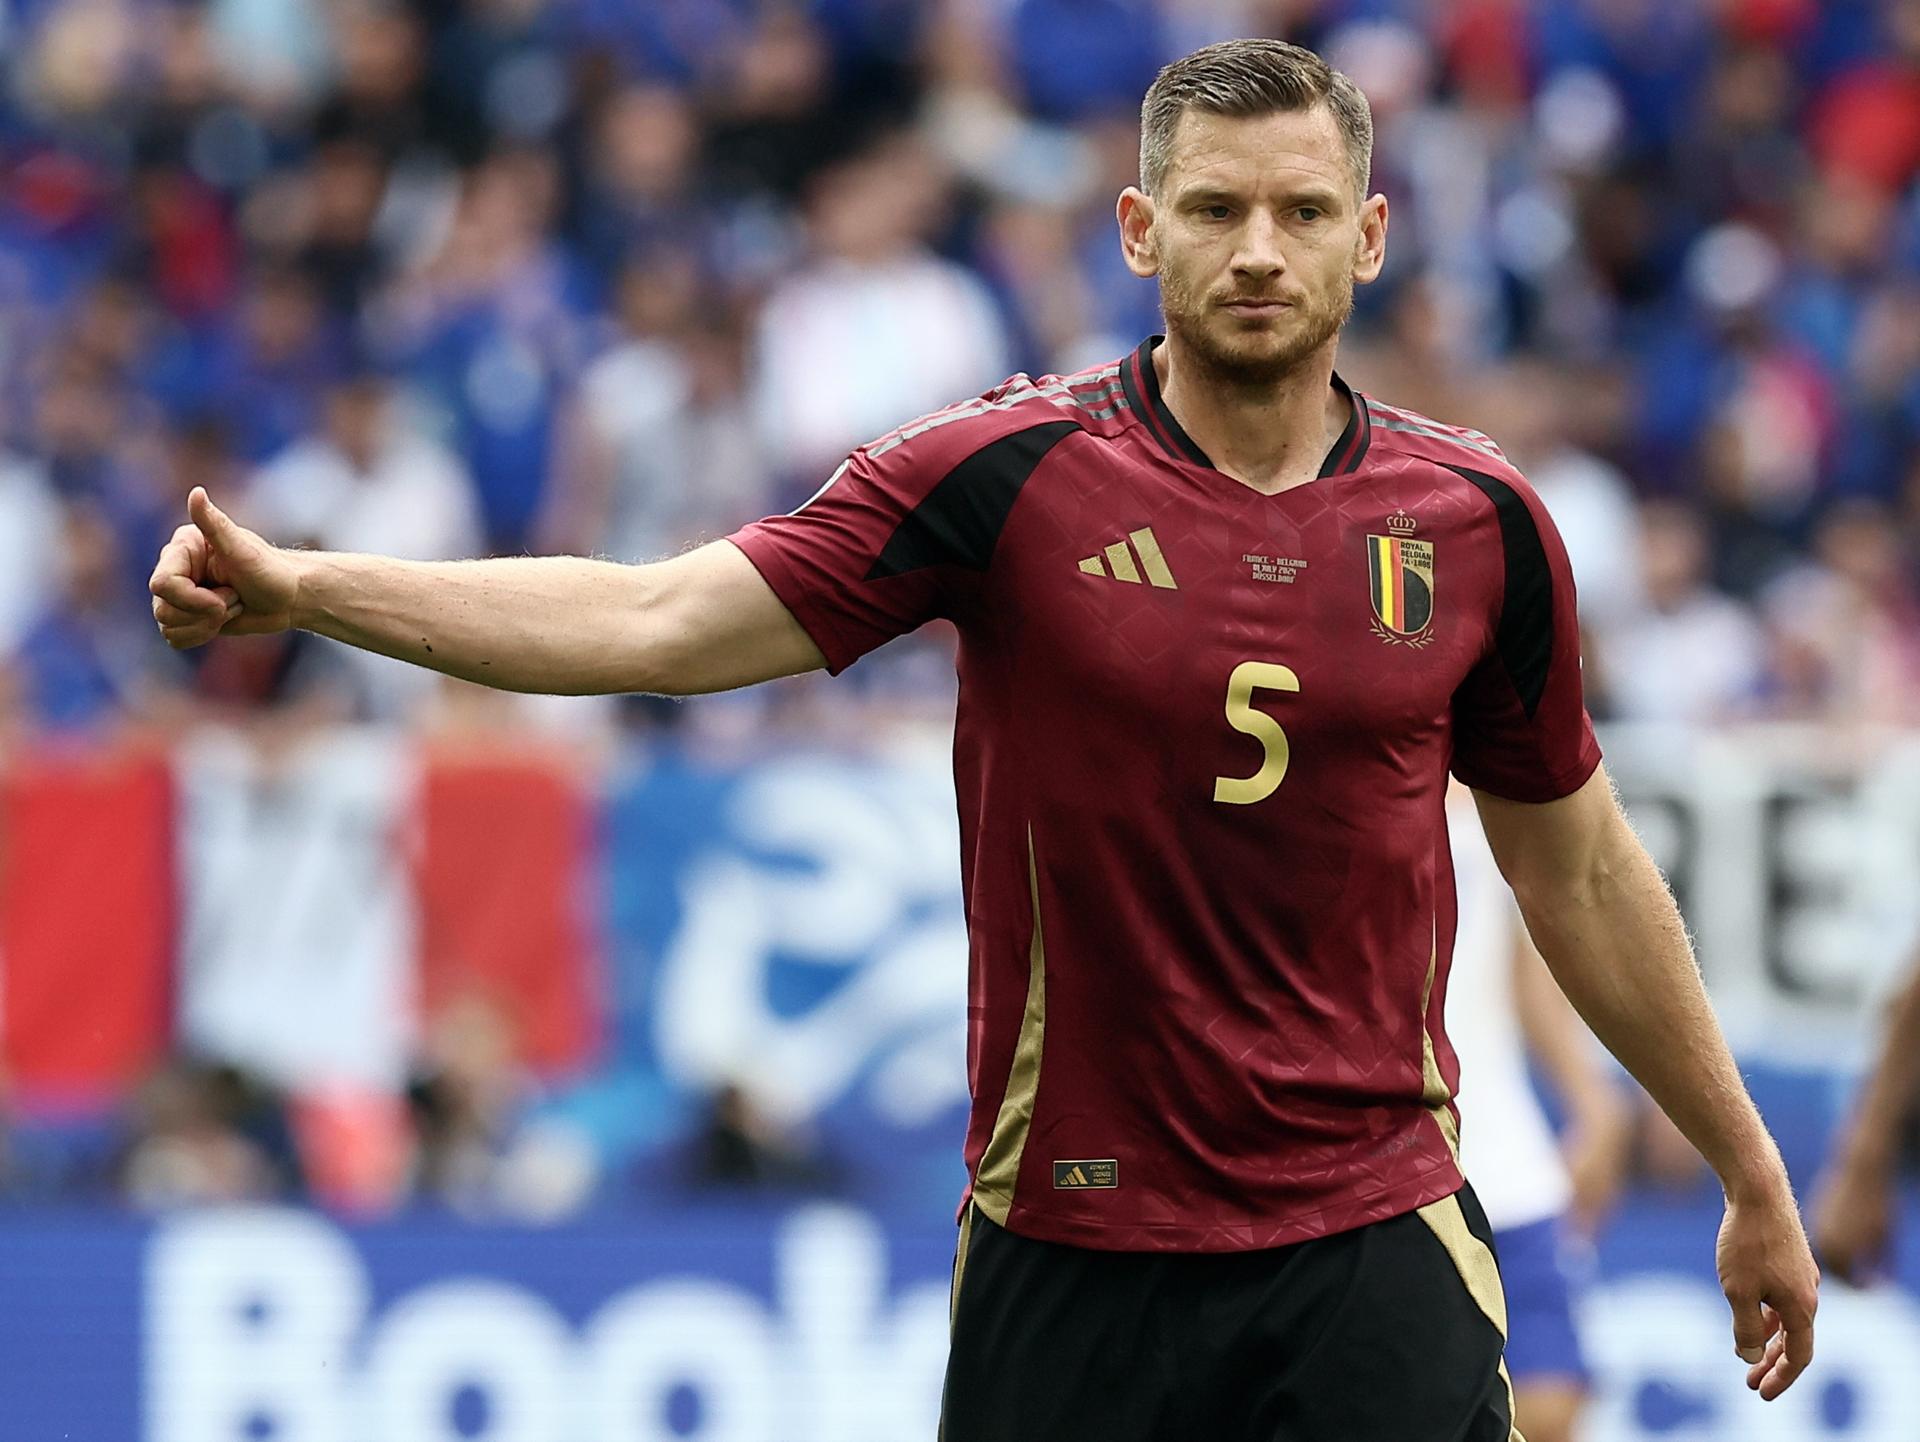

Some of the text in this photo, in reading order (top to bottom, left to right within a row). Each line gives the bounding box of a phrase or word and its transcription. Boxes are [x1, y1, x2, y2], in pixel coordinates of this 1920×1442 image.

[1400, 541, 1424, 551] ROYAL
[1242, 554, 1269, 564] FRANCE
[1400, 549, 1432, 561] BELGIAN
[1261, 565, 1277, 573] JULY
[1278, 566, 1297, 575] 2024
[1213, 661, 1300, 804] 5
